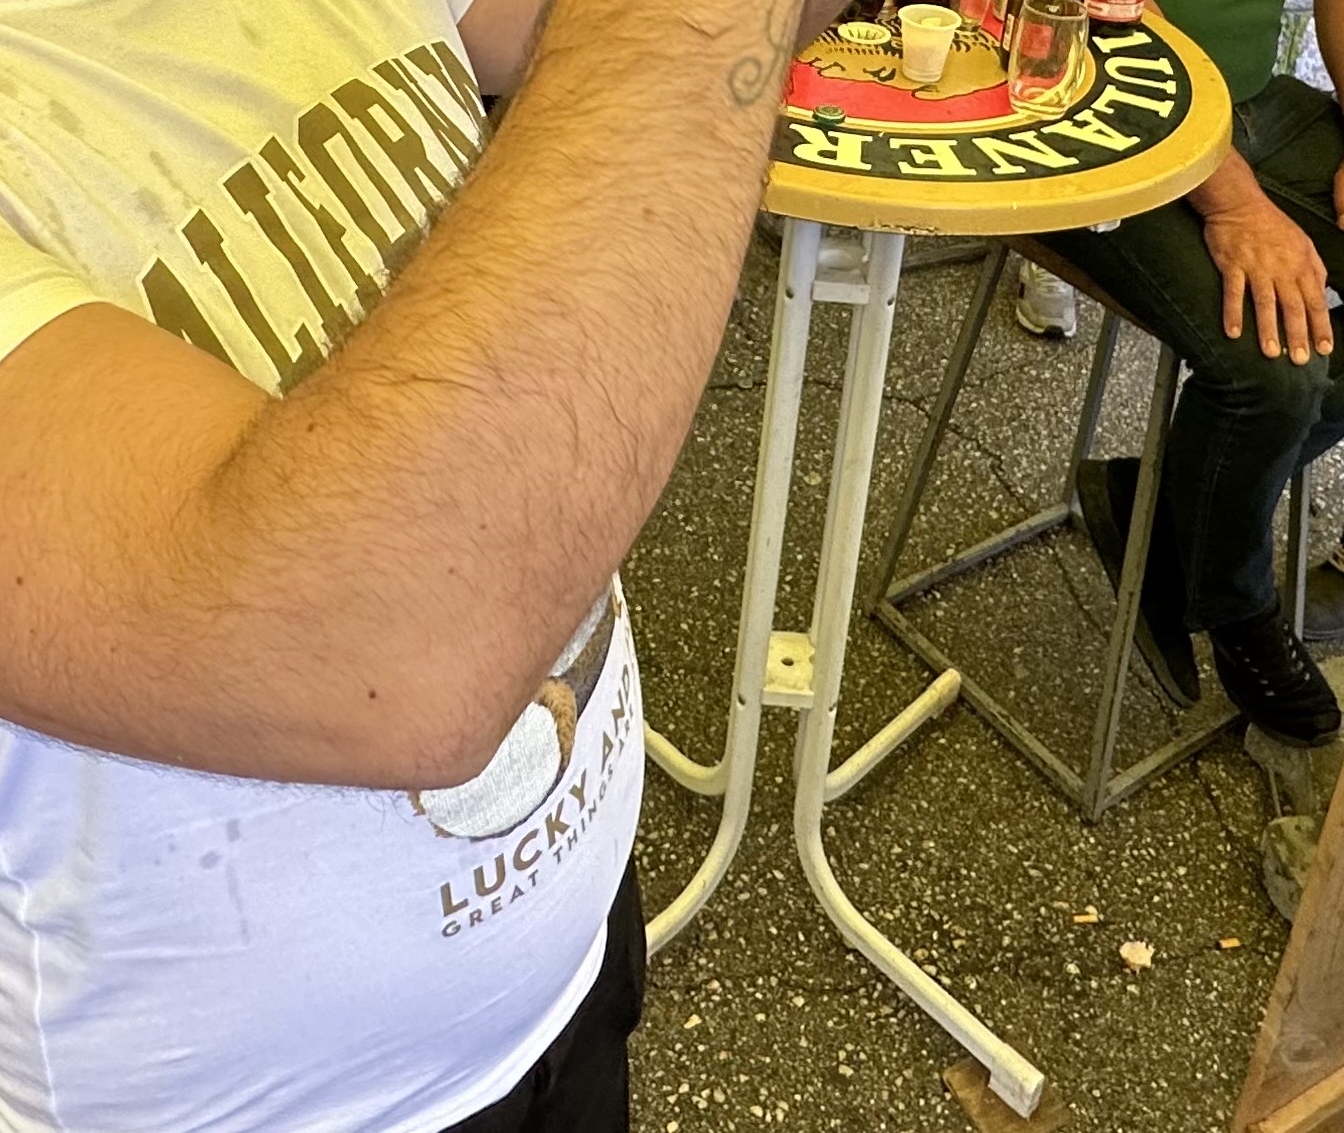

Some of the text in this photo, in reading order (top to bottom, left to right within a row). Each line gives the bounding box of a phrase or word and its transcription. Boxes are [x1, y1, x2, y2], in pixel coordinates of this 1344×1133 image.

[788, 30, 1179, 177] ULANER
[439, 664, 631, 918] LUCKY AND
[441, 869, 540, 938] GREAT
[552, 763, 614, 864] THINGS
